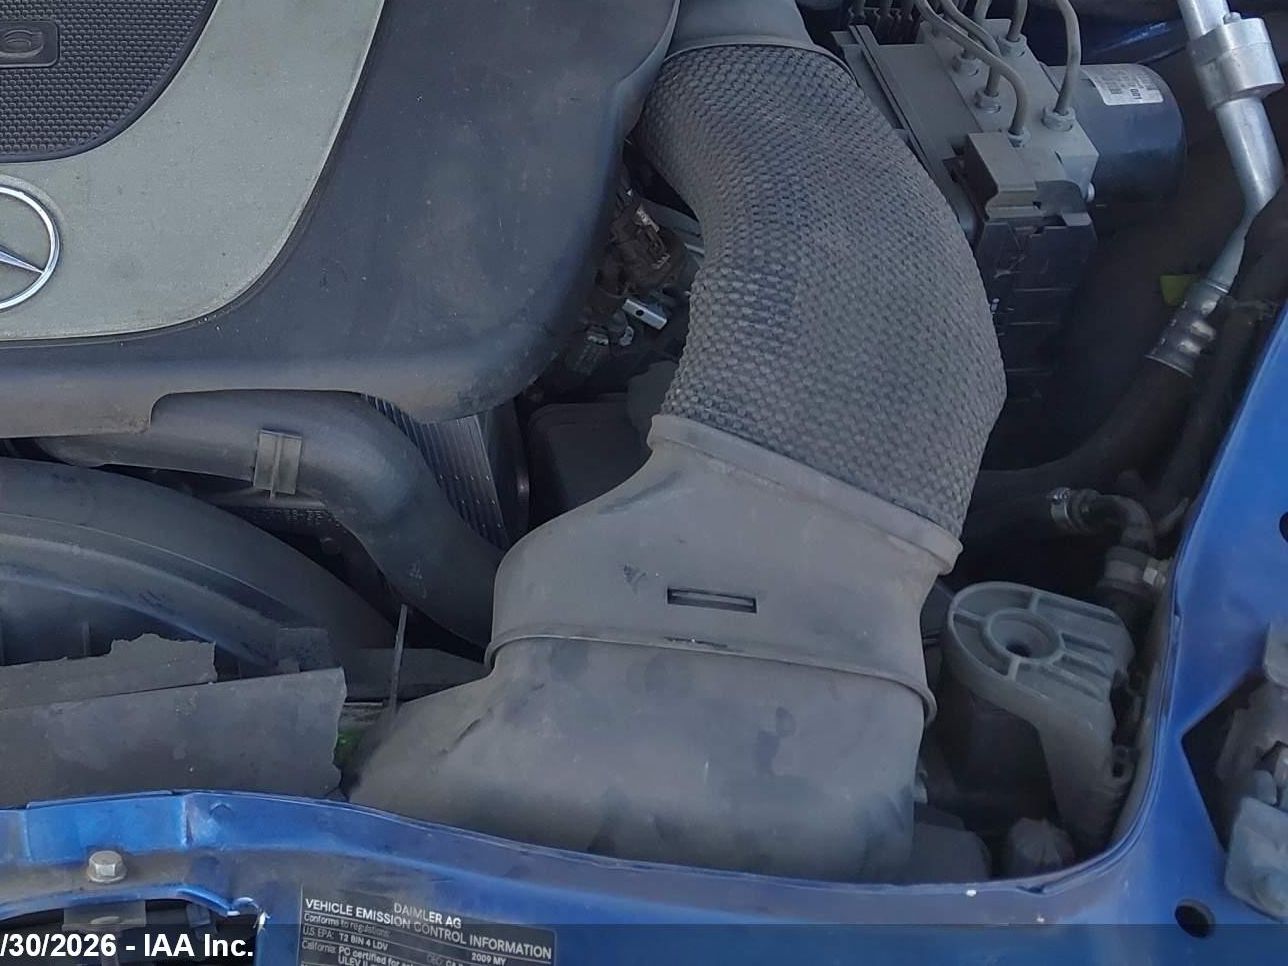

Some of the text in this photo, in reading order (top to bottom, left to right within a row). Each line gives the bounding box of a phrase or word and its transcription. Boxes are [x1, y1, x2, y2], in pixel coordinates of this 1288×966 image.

[303, 913, 339, 926] Conforms
[341, 919, 349, 928] to
[394, 902, 462, 929] DAIMLER AG
[305, 898, 552, 960] VEHICLE EMISSION CONTROL INFORMATION
[340, 931, 349, 942] T2
[350, 934, 364, 945] BIN
[365, 938, 371, 947] 4
[372, 939, 389, 951] LDV
[338, 945, 351, 956] PC
[471, 952, 507, 966] 2009 MY
